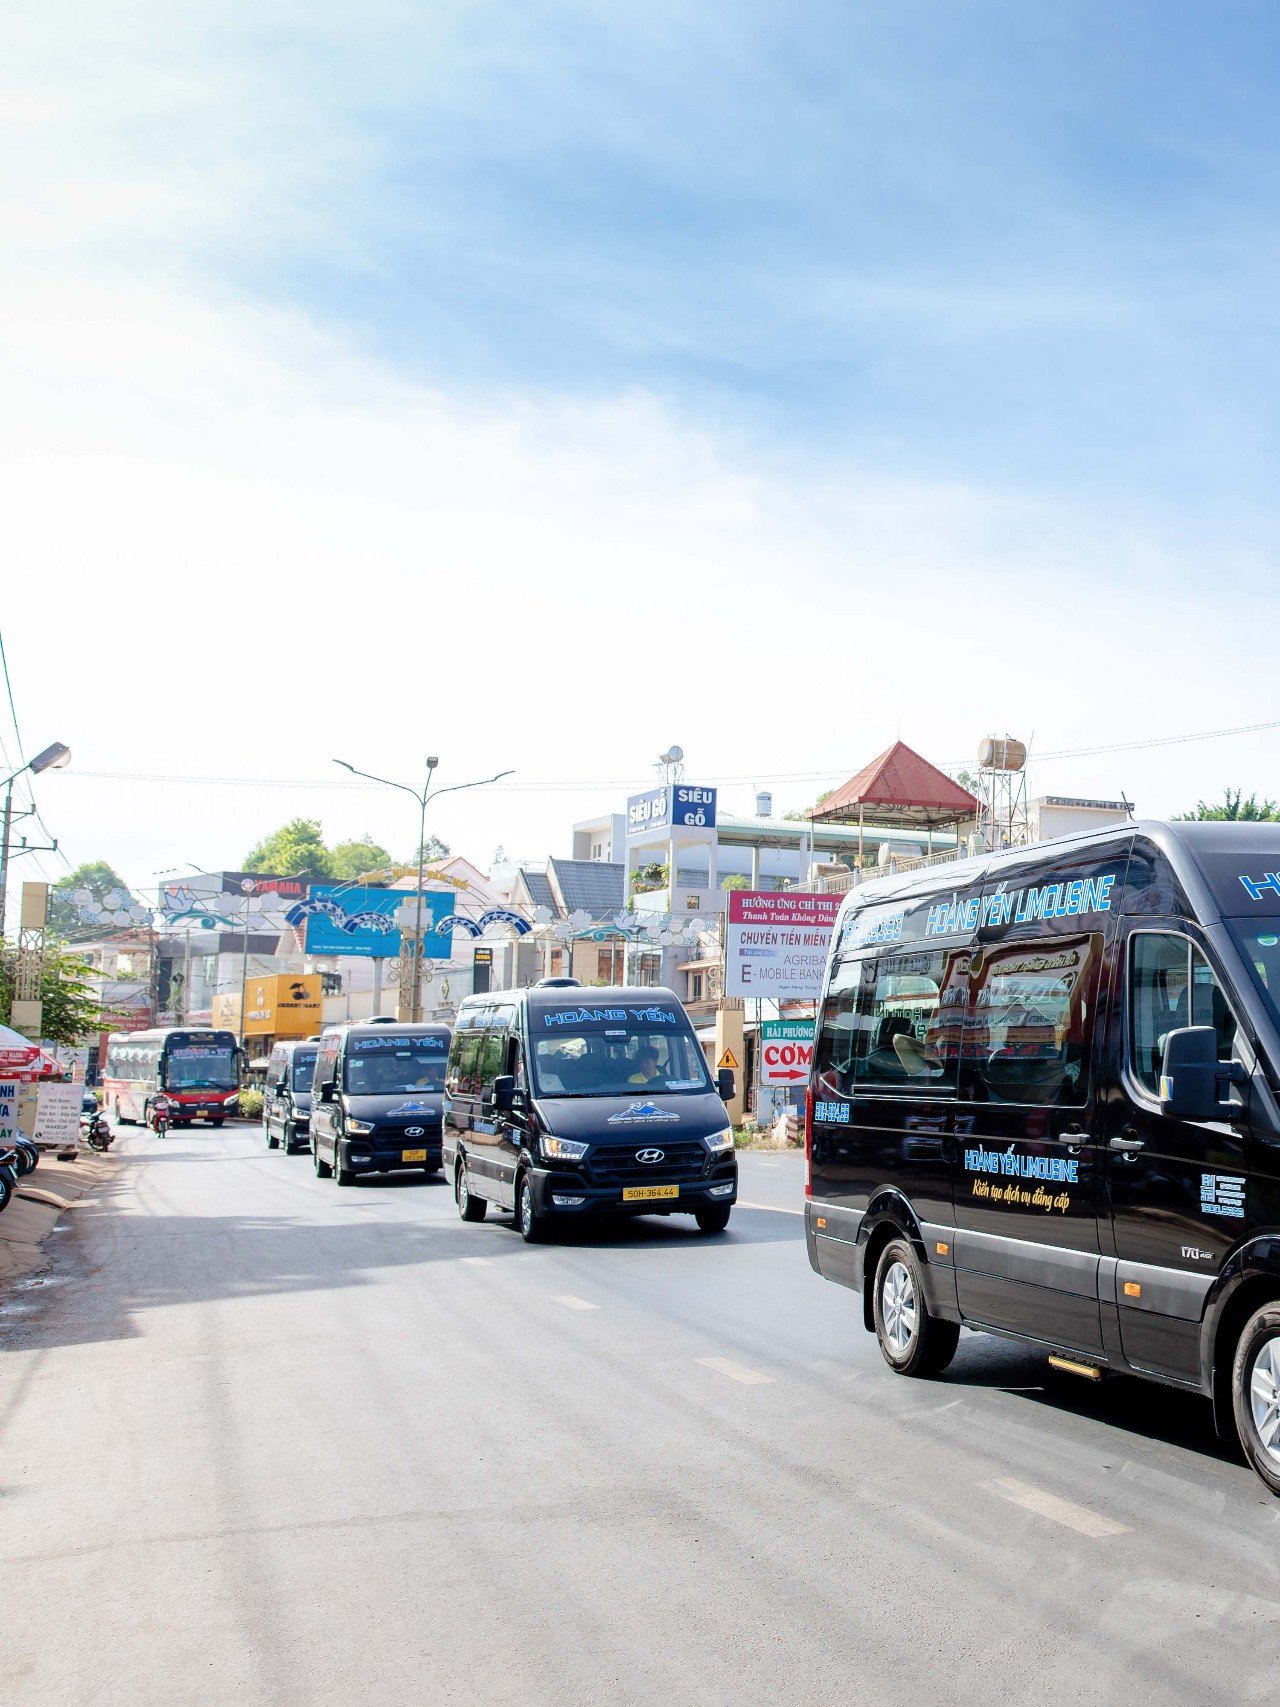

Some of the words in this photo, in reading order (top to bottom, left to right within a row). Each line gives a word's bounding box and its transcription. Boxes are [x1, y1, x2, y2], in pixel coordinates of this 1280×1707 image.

[678, 788, 712, 804] SIÊU
[629, 799, 652, 824] SIÊU
[652, 788, 667, 818] GỖ
[684, 808, 706, 826] GỖ
[255, 880, 300, 894] YAMAHA
[742, 896, 774, 909] HƯỞNG
[777, 898, 796, 909] ỨNG
[799, 898, 815, 910] CHỈ
[817, 901, 833, 912] THỊ
[925, 893, 980, 936] HOÀNG
[980, 881, 1014, 927] YẾN
[1014, 874, 1116, 924] LIMOUSINE
[743, 912, 767, 920] Thanh
[770, 913, 789, 921] Toán
[791, 913, 816, 923] Không
[818, 914, 837, 923] Dùng
[740, 926, 778, 945] CHUYỂN
[784, 955, 826, 966] AGRIBA
[741, 964, 751, 983] E
[760, 968, 796, 980] MOBILE
[800, 969, 824, 980] BANK
[544, 1008, 627, 1026] HOÀNG
[629, 1007, 676, 1024] YẾN
[767, 1024, 782, 1037] HẢI
[783, 1026, 814, 1038] PHƯƠNG
[354, 1038, 410, 1050] HOÀNG
[413, 1037, 444, 1048] YẾN
[764, 1042, 813, 1066] CƠM
[0, 1086, 14, 1098] NH
[0, 1128, 12, 1138] ÁY
[964, 1144, 999, 1174] HOÀNG
[999, 1144, 1020, 1176] YẾN
[1020, 1156, 1079, 1183] LIMOUSINE
[628, 1188, 674, 1198] 50H-364.44
[972, 1179, 989, 1197] Kiến
[990, 1184, 1002, 1201] tạo
[1004, 1184, 1020, 1204] dịch
[1021, 1190, 1031, 1206] vụ
[1032, 1186, 1053, 1212] đẳng
[1054, 1192, 1070, 1214] cấp
